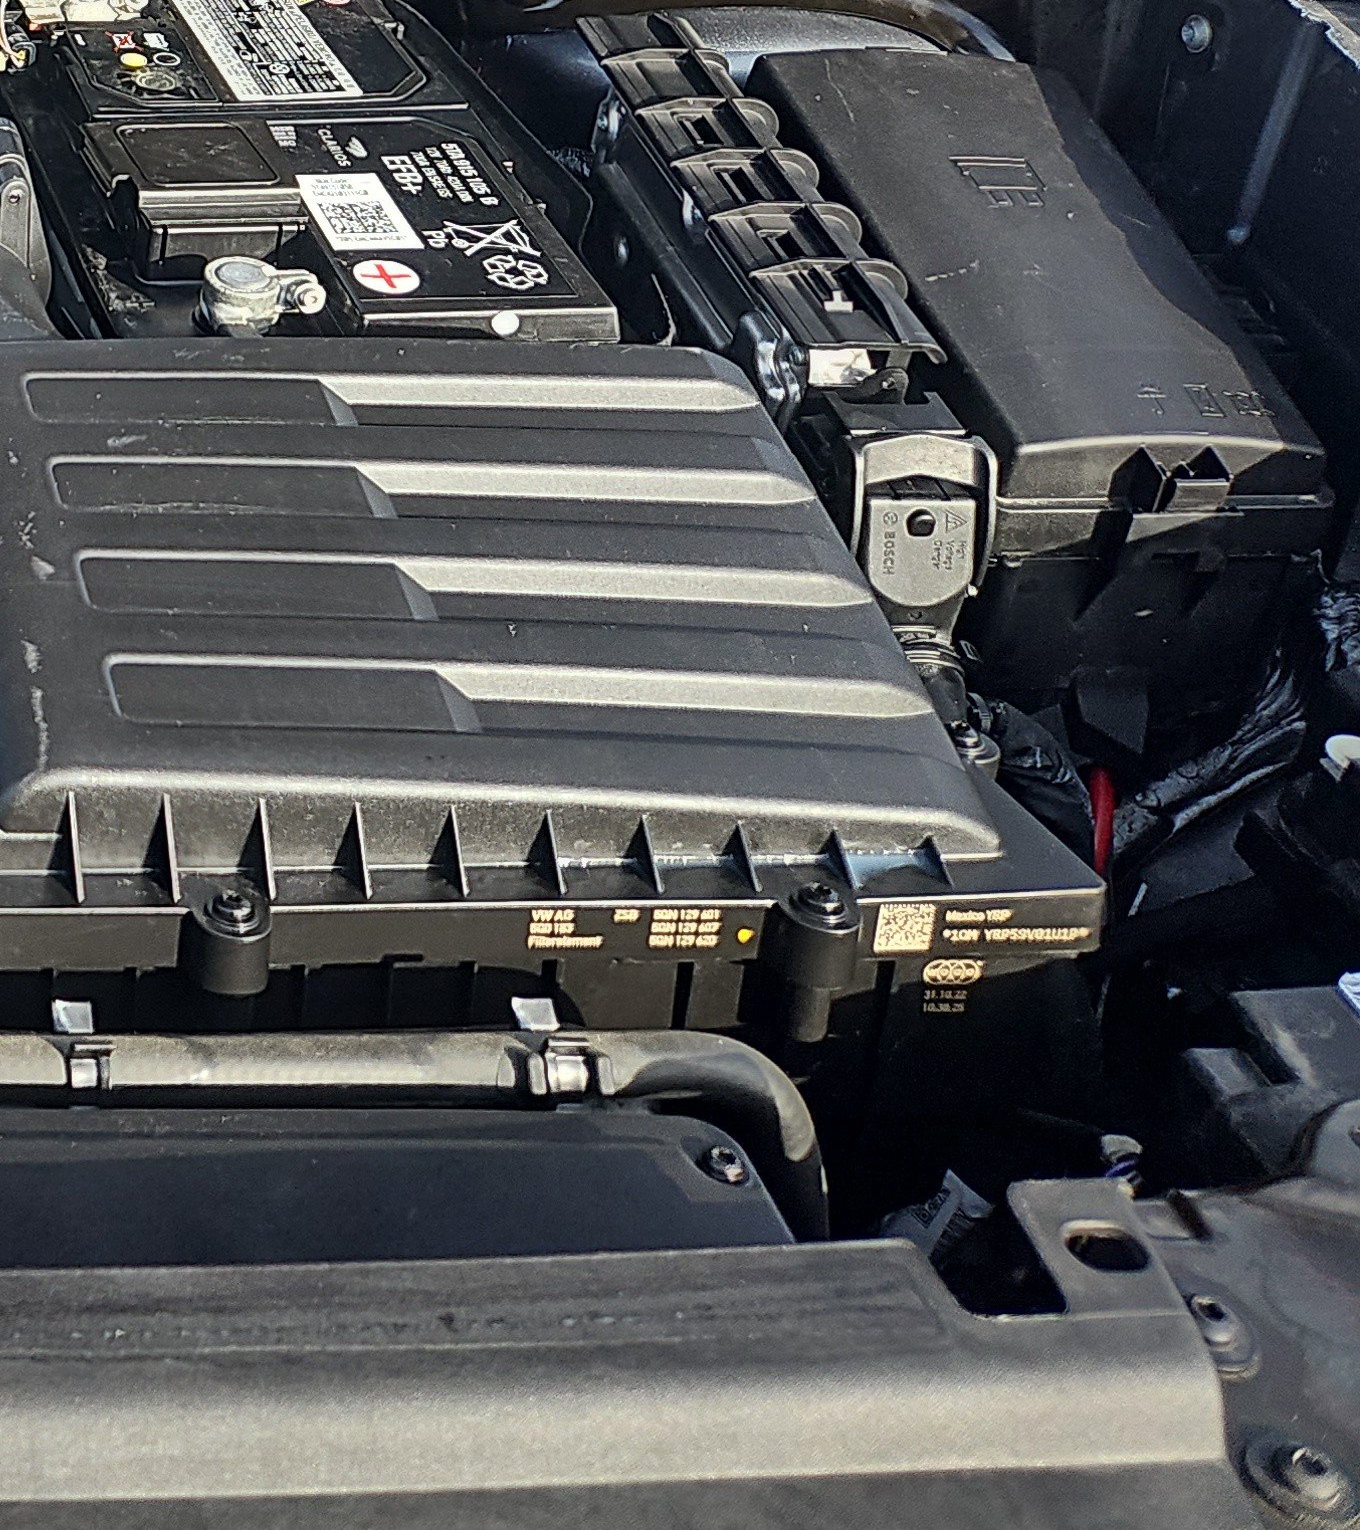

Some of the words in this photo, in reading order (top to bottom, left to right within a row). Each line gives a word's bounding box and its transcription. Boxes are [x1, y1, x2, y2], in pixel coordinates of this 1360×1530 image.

[317, 128, 352, 168] CLARIOS
[381, 155, 423, 196] EFB+
[422, 230, 448, 249] Pb
[883, 531, 896, 576] BOSCH
[945, 910, 985, 923] Mexico
